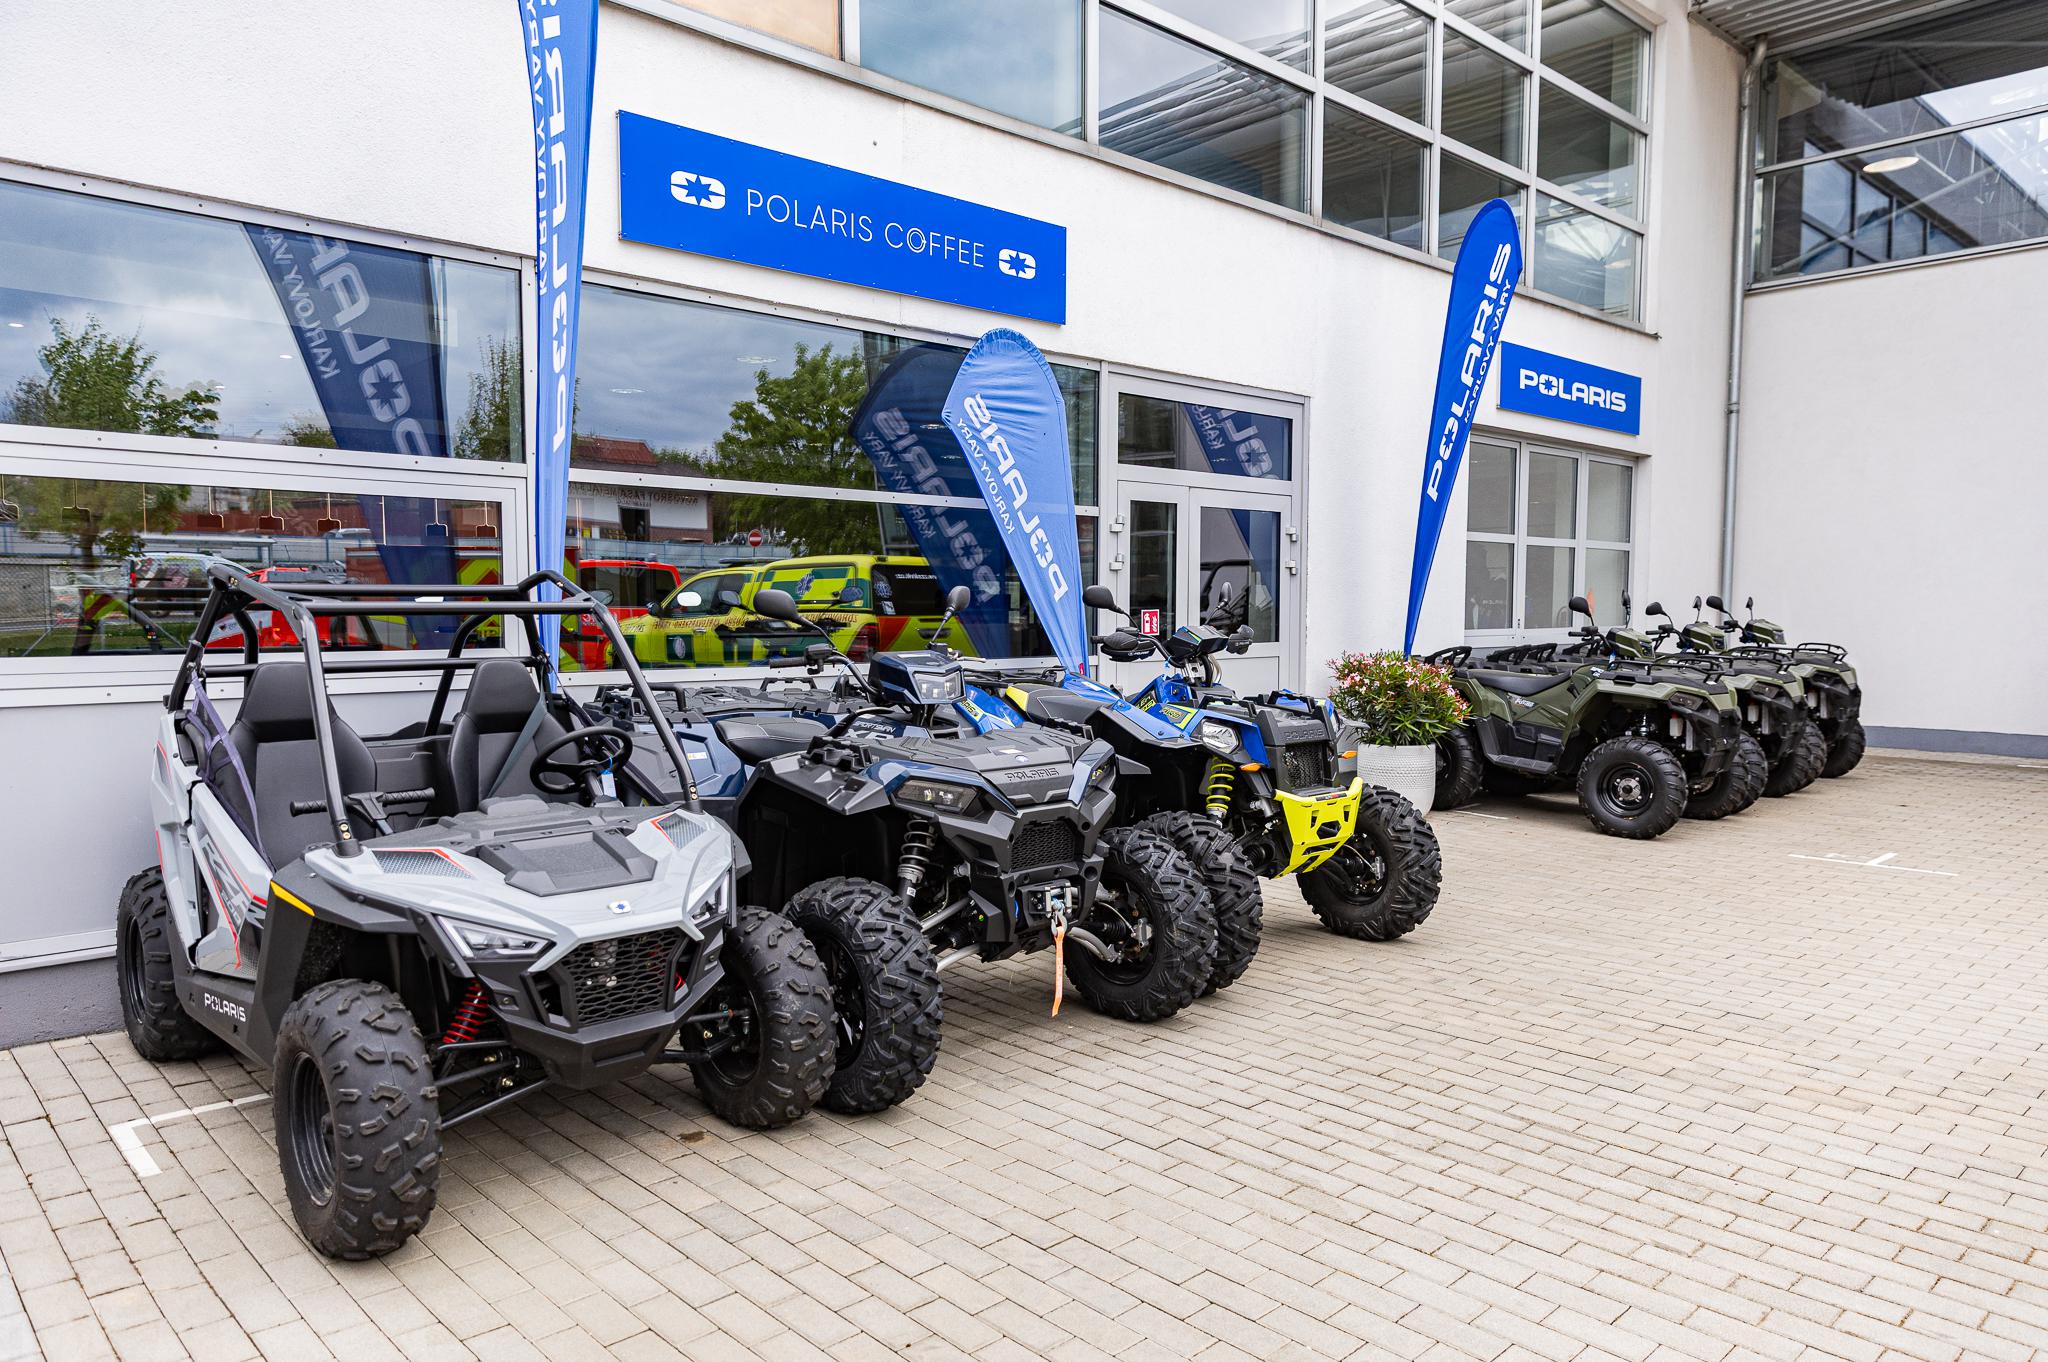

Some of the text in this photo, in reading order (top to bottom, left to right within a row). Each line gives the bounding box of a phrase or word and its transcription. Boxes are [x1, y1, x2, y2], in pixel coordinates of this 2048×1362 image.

[747, 188, 985, 268] POLARIS COFFEE
[1426, 242, 1512, 502] POLARIS
[1464, 278, 1512, 424] KARLOVY VARY
[1519, 367, 1627, 413] POLARIS
[1283, 728, 1326, 741] POLARIS
[1004, 767, 1060, 782] POLARIS
[203, 992, 247, 1023] POLARIS
